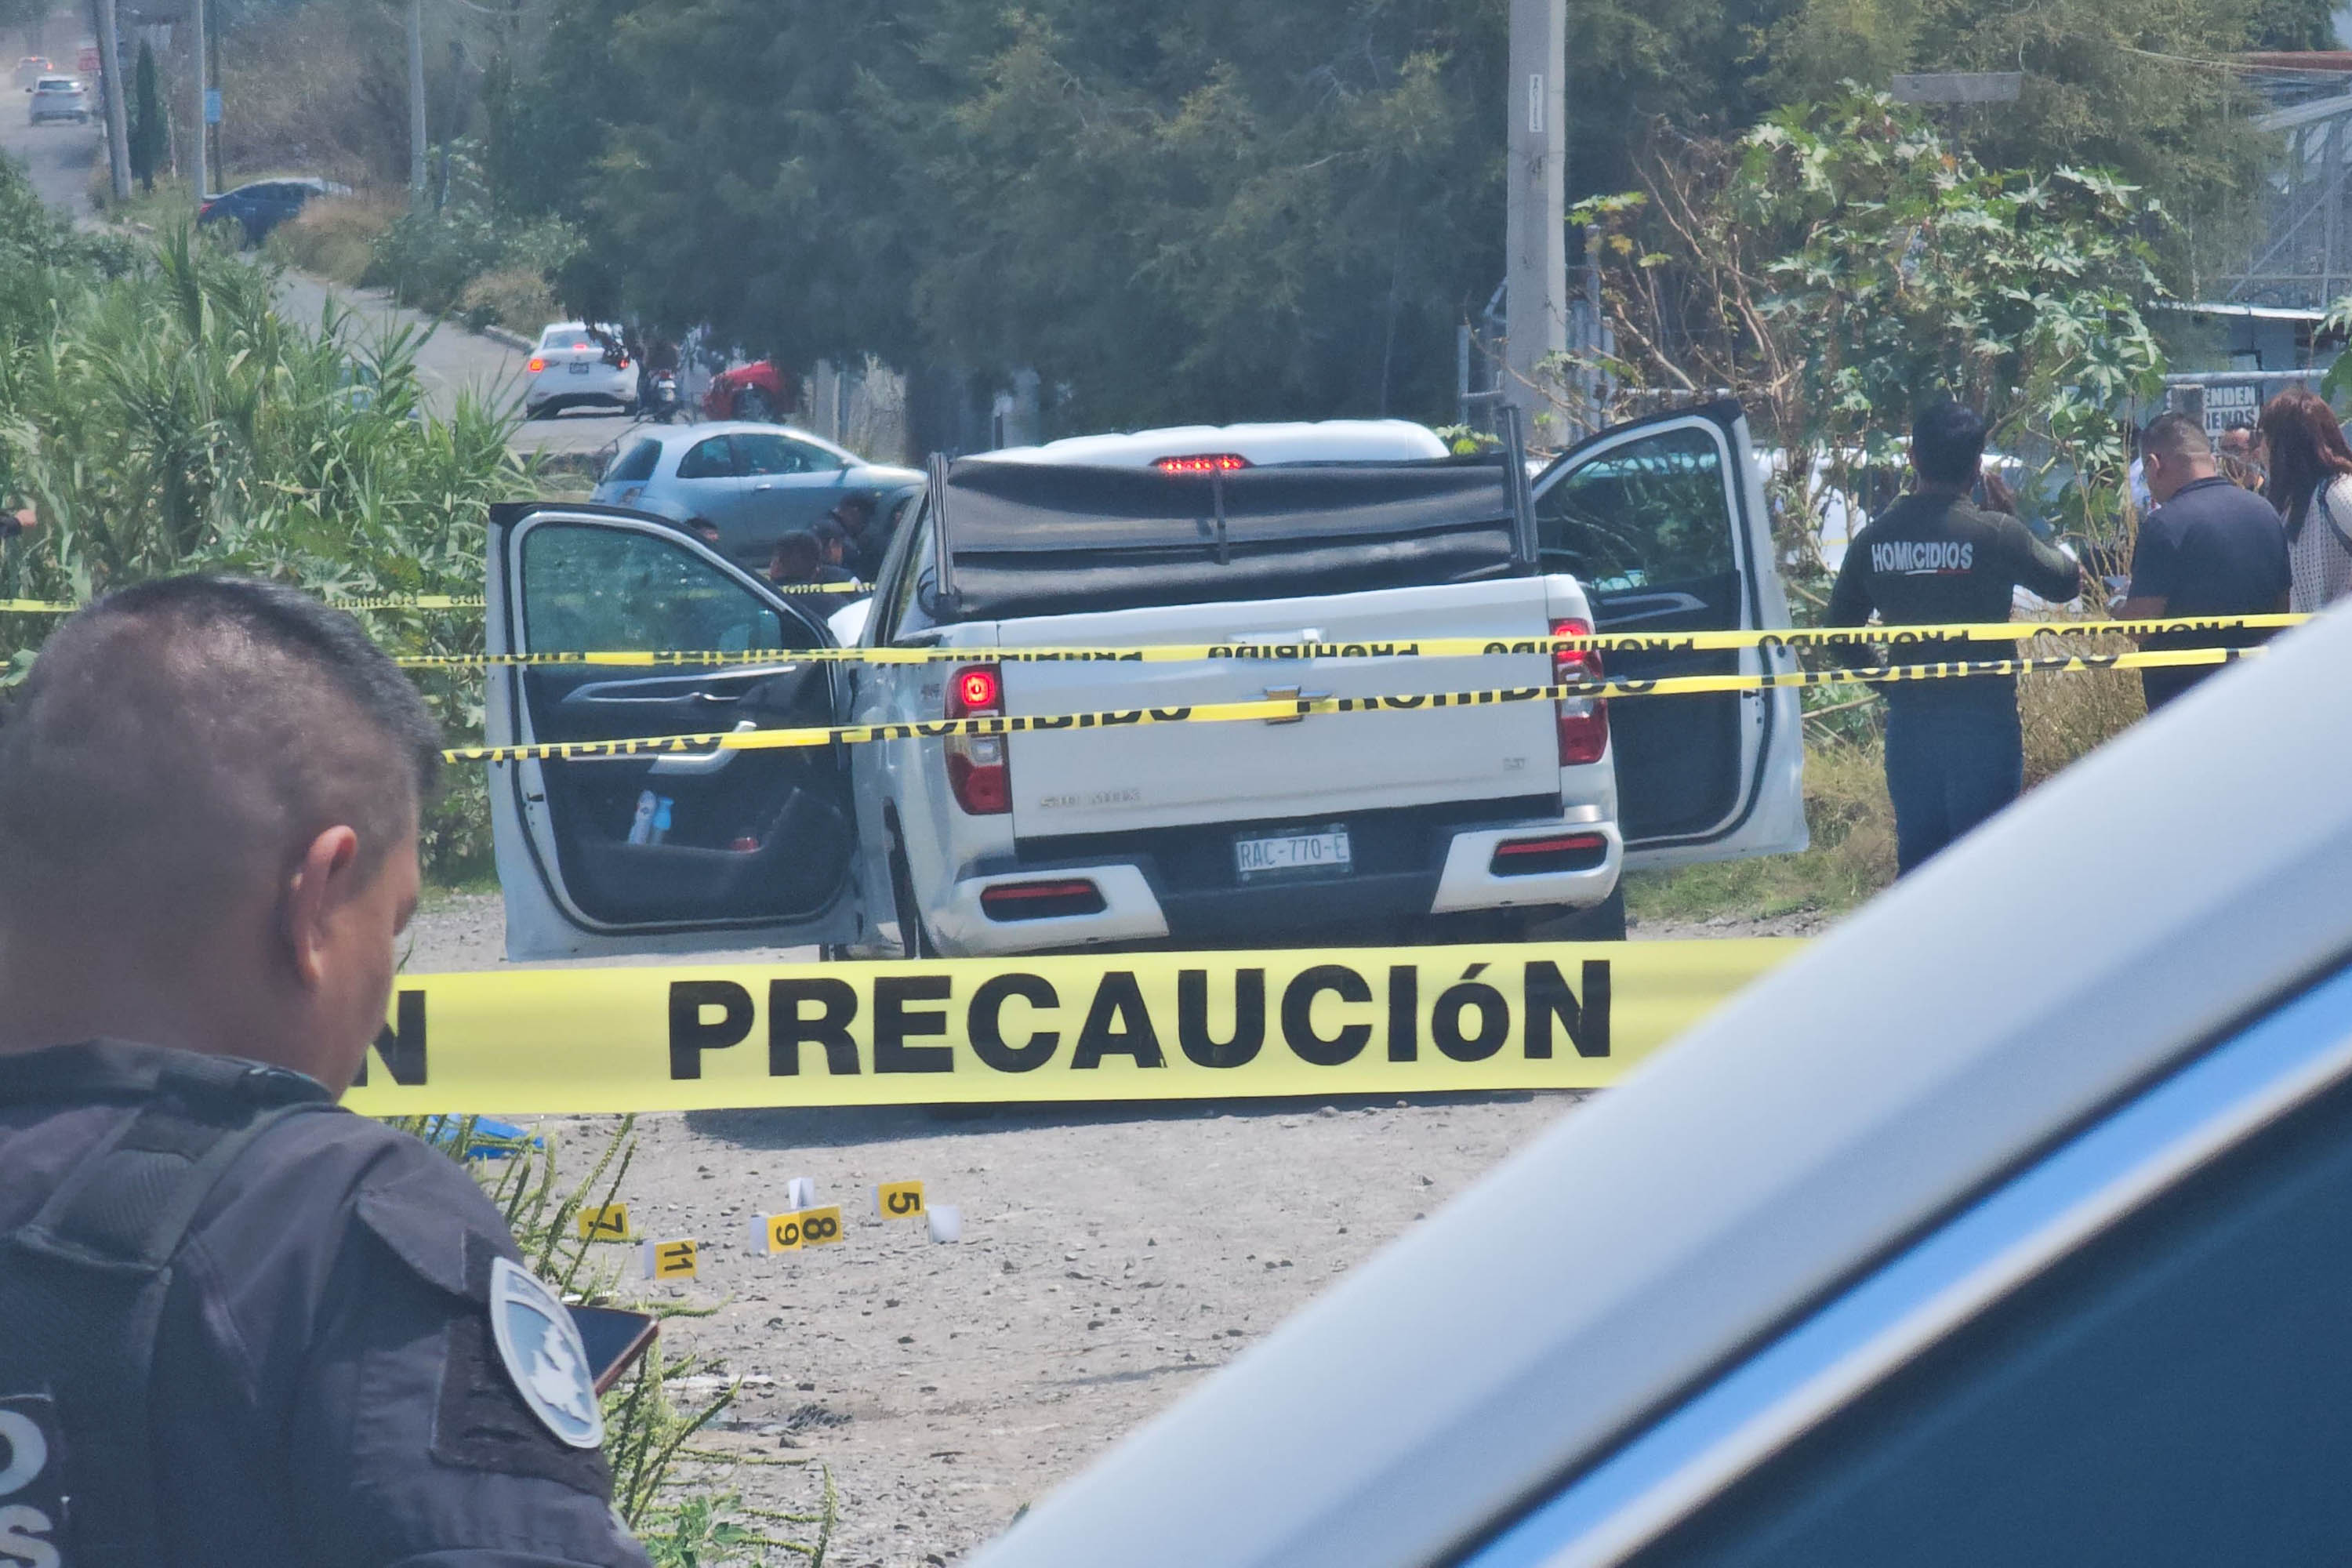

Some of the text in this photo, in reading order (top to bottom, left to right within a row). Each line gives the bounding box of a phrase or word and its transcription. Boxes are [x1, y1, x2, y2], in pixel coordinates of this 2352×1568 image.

[2204, 386, 2256, 408] ENDEN
[1871, 541, 1973, 572] HOMICIDIOS
[888, 1191, 920, 1214] 5
[588, 1213, 623, 1233] 7
[802, 1217, 837, 1240] 8
[664, 1243, 693, 1272] 11
